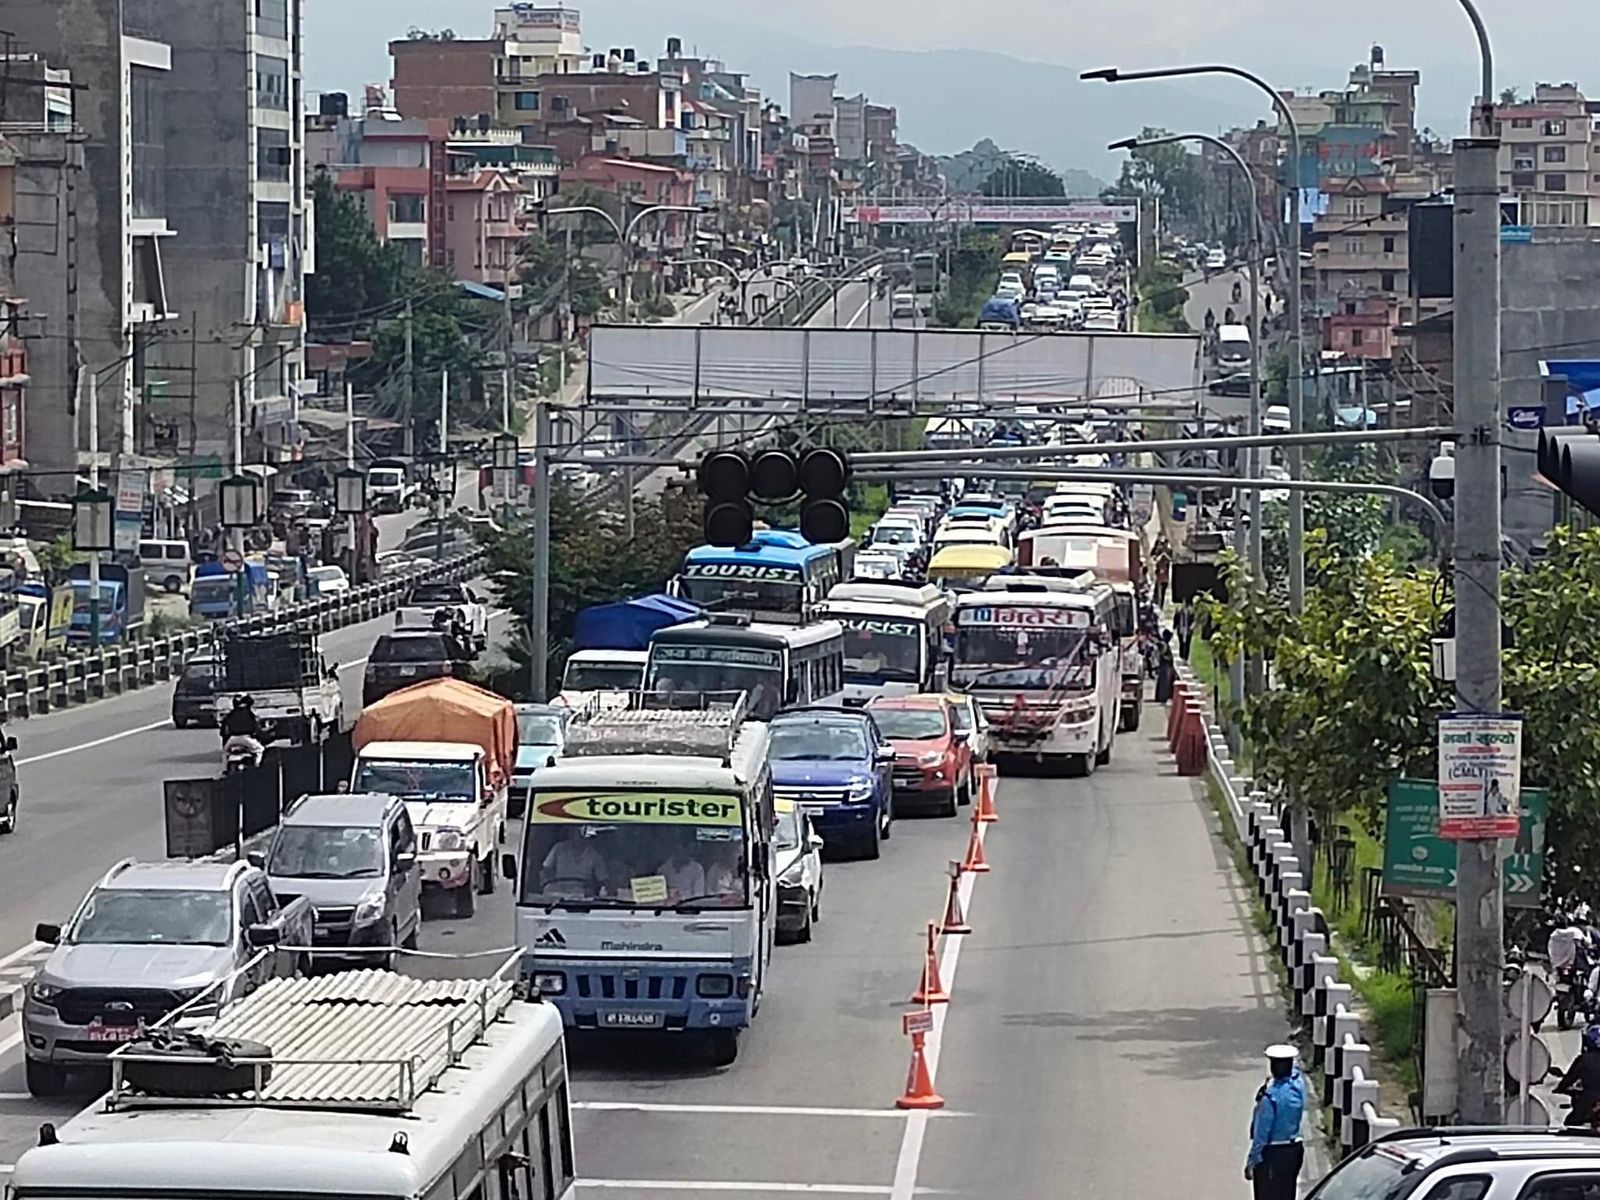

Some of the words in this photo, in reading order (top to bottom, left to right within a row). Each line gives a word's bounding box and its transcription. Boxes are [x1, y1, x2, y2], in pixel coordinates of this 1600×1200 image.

[686, 564, 800, 581] TOURIST
[586, 798, 736, 818] tourister
[601, 941, 663, 951] Mahindra
